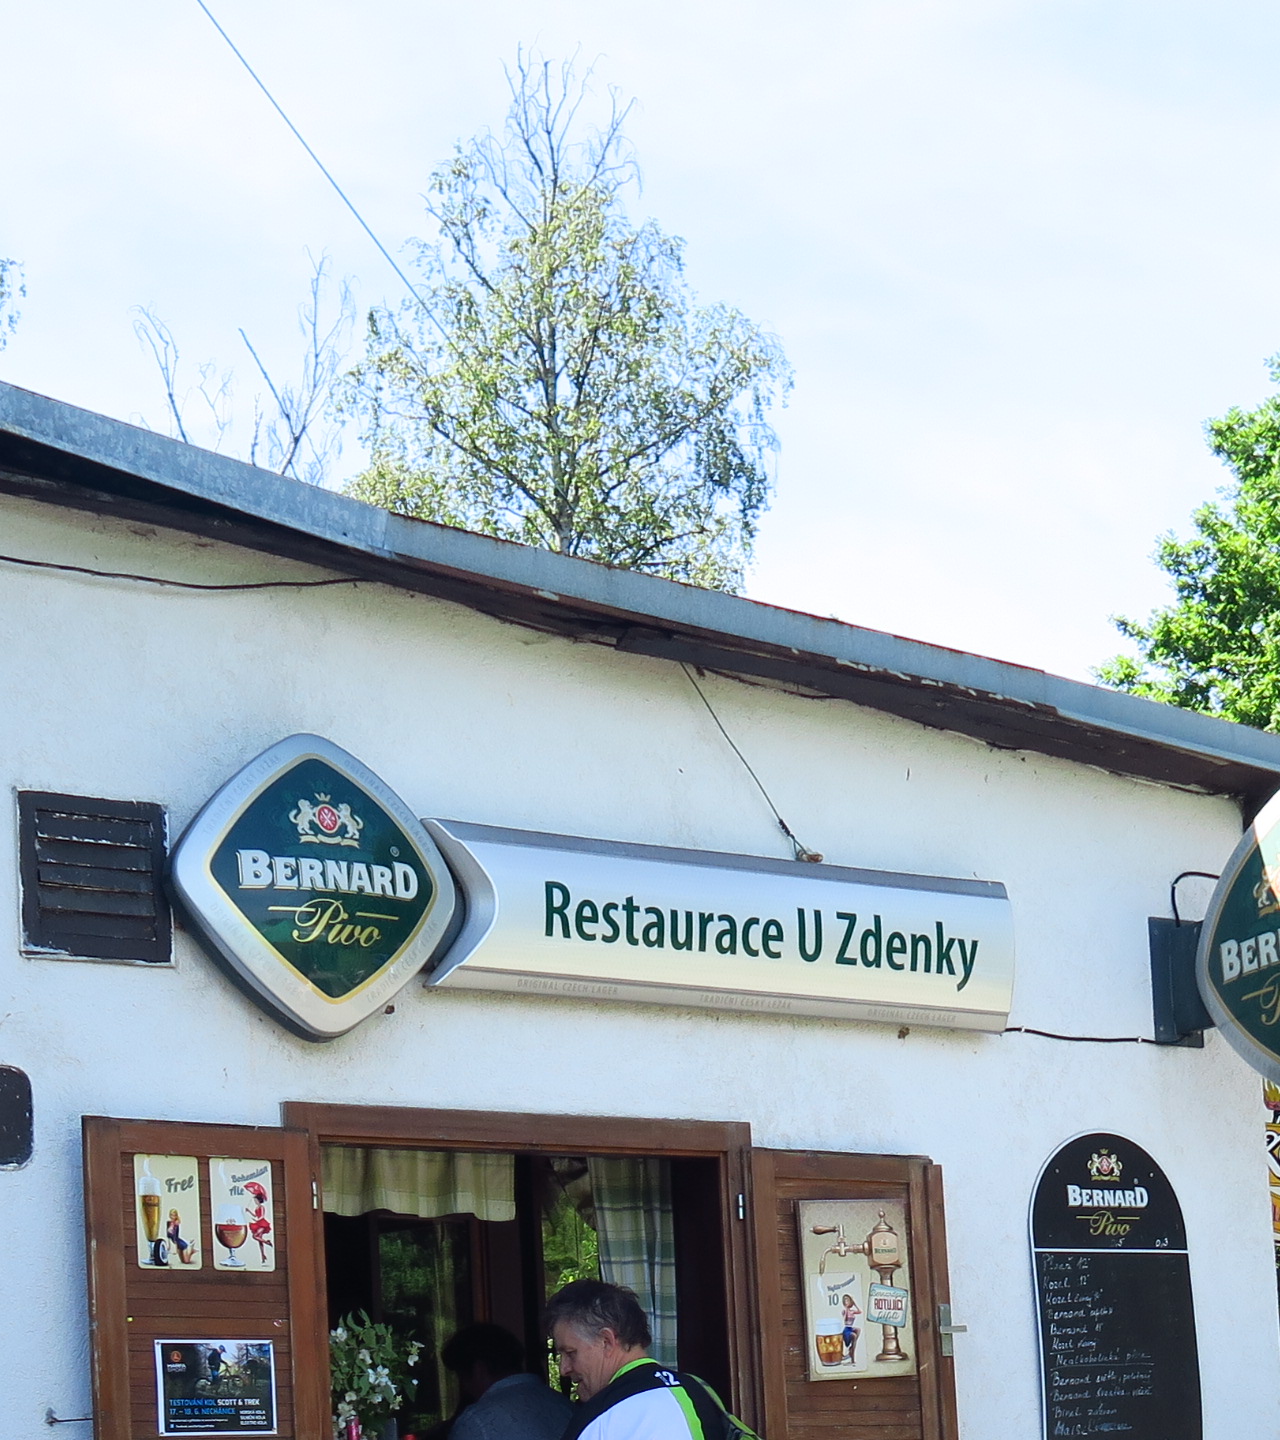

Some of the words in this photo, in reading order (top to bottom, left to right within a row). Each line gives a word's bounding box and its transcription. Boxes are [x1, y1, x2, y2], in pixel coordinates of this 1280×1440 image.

[236, 849, 418, 900] BERNARD
[292, 898, 381, 947] Pivo
[544, 881, 784, 959] Restaurace
[797, 907, 823, 963] U
[835, 912, 978, 992] Zdenky
[517, 979, 559, 991] ORIGINAL
[562, 982, 589, 993] CZECH
[591, 985, 618, 995] LAGER
[867, 1007, 905, 1019] ORIGINAL
[906, 1011, 929, 1021] CZECH
[231, 1166, 268, 1183] Bohemian
[165, 1175, 194, 1193] Free
[229, 1185, 244, 1196] Ale
[1067, 1185, 1148, 1208] BERNARD
[1090, 1211, 1131, 1235] Pivo
[828, 1293, 839, 1306] 10
[1045, 1292, 1072, 1305] Kozel
[655, 1370, 681, 1386] 12
[217, 1398, 236, 1406] SCOTT
[244, 1398, 260, 1406] TREK
